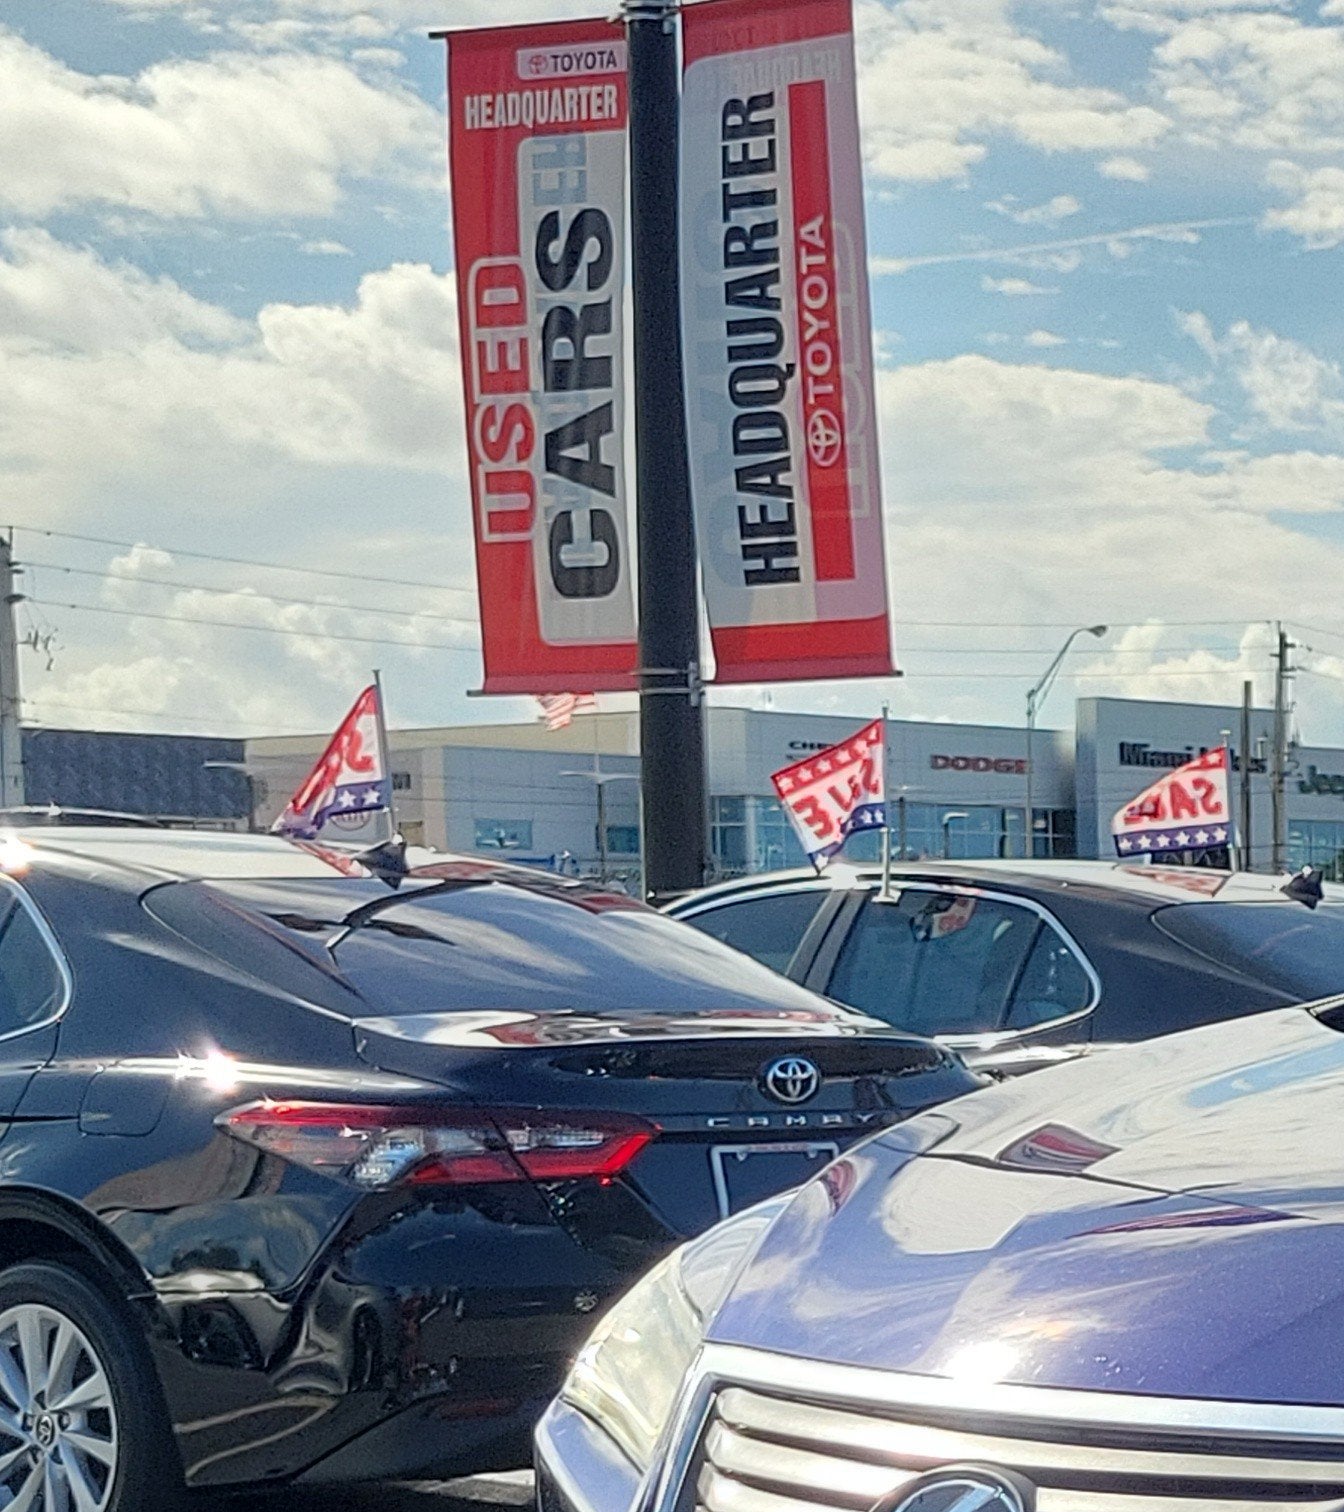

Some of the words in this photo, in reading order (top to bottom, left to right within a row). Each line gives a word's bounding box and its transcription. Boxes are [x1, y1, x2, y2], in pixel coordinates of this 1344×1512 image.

[464, 85, 618, 130] HEADQUARTER
[552, 51, 617, 73] TOYOTA
[468, 255, 537, 542] USED
[534, 206, 621, 600] CARS
[720, 90, 800, 587] HEADQUARTER
[800, 215, 836, 413] TOYOTA
[707, 1113, 875, 1127] CAMRY
